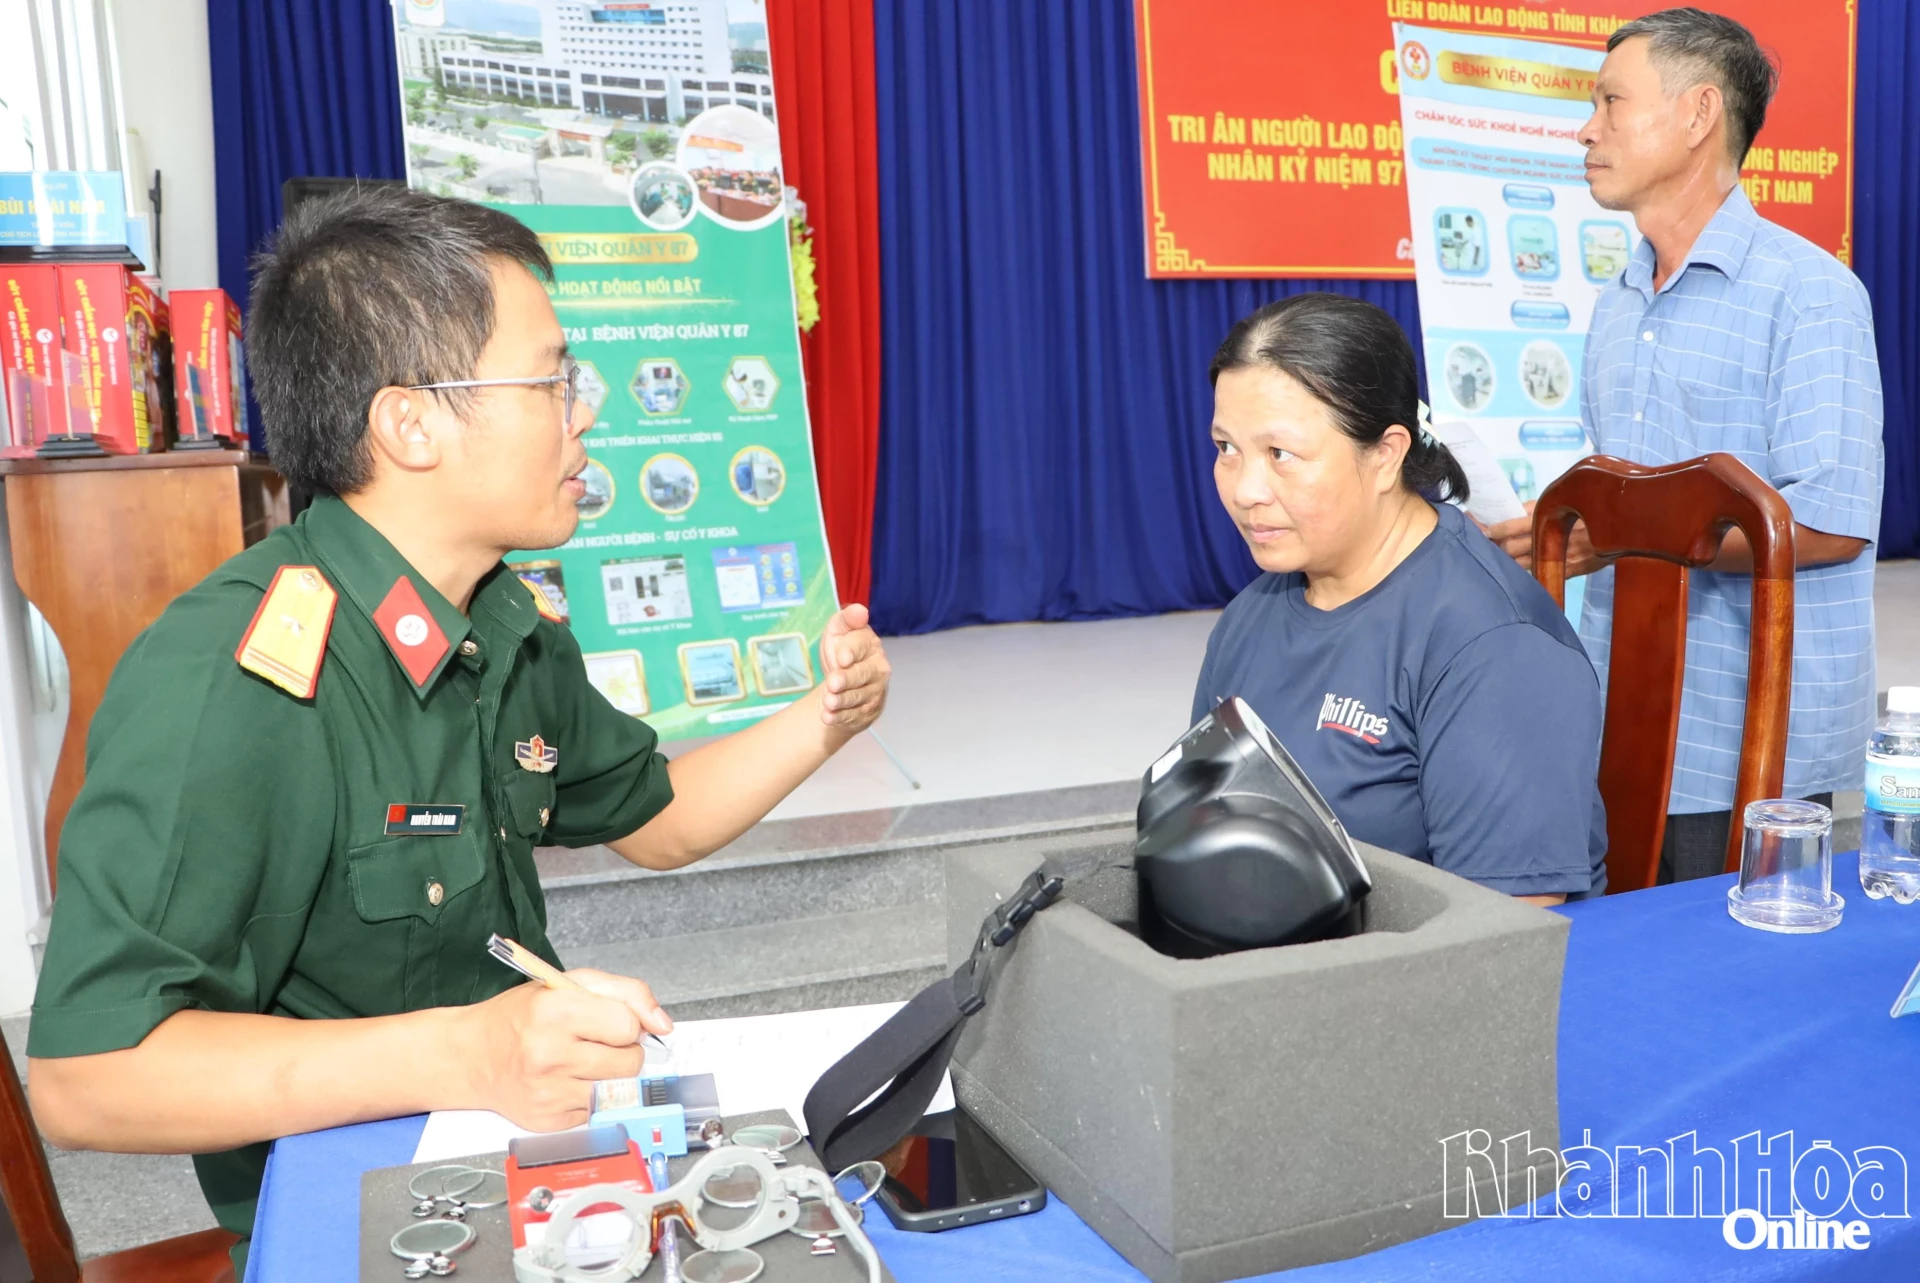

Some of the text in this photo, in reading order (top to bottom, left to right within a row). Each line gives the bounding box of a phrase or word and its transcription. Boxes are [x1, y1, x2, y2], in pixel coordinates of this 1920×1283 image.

[1474, 6, 1504, 26] LAO
[1507, 6, 1549, 32] ĐỘNG
[1552, 10, 1586, 34] TỈNH
[1589, 14, 1628, 36] KHÁ
[1452, 60, 1490, 79] BỆNH
[1495, 66, 1526, 86] VIỆN
[1531, 72, 1571, 90] QUÂN
[1575, 79, 1583, 91] Y
[1168, 111, 1403, 157] TRI ÂN NGƯỜI LAO ĐỘ
[1548, 128, 1577, 141] NGHIỆ
[1208, 148, 1403, 190] NHÂN KỶ NIỆM 97
[1778, 147, 1839, 179] NGHIỆP
[1740, 174, 1813, 207] IỆT NAM
[556, 239, 597, 259] VIỆN
[601, 239, 652, 256] QUÂN
[654, 241, 668, 256] Y
[671, 241, 689, 256] 87
[558, 280, 598, 297] HOẠT
[602, 278, 642, 298] ĐỘNG
[592, 324, 636, 341] BỆNH
[638, 323, 674, 341] VIỆN
[677, 323, 719, 339] QUÂN
[721, 325, 732, 337] Y
[1880, 775, 1920, 798] San
